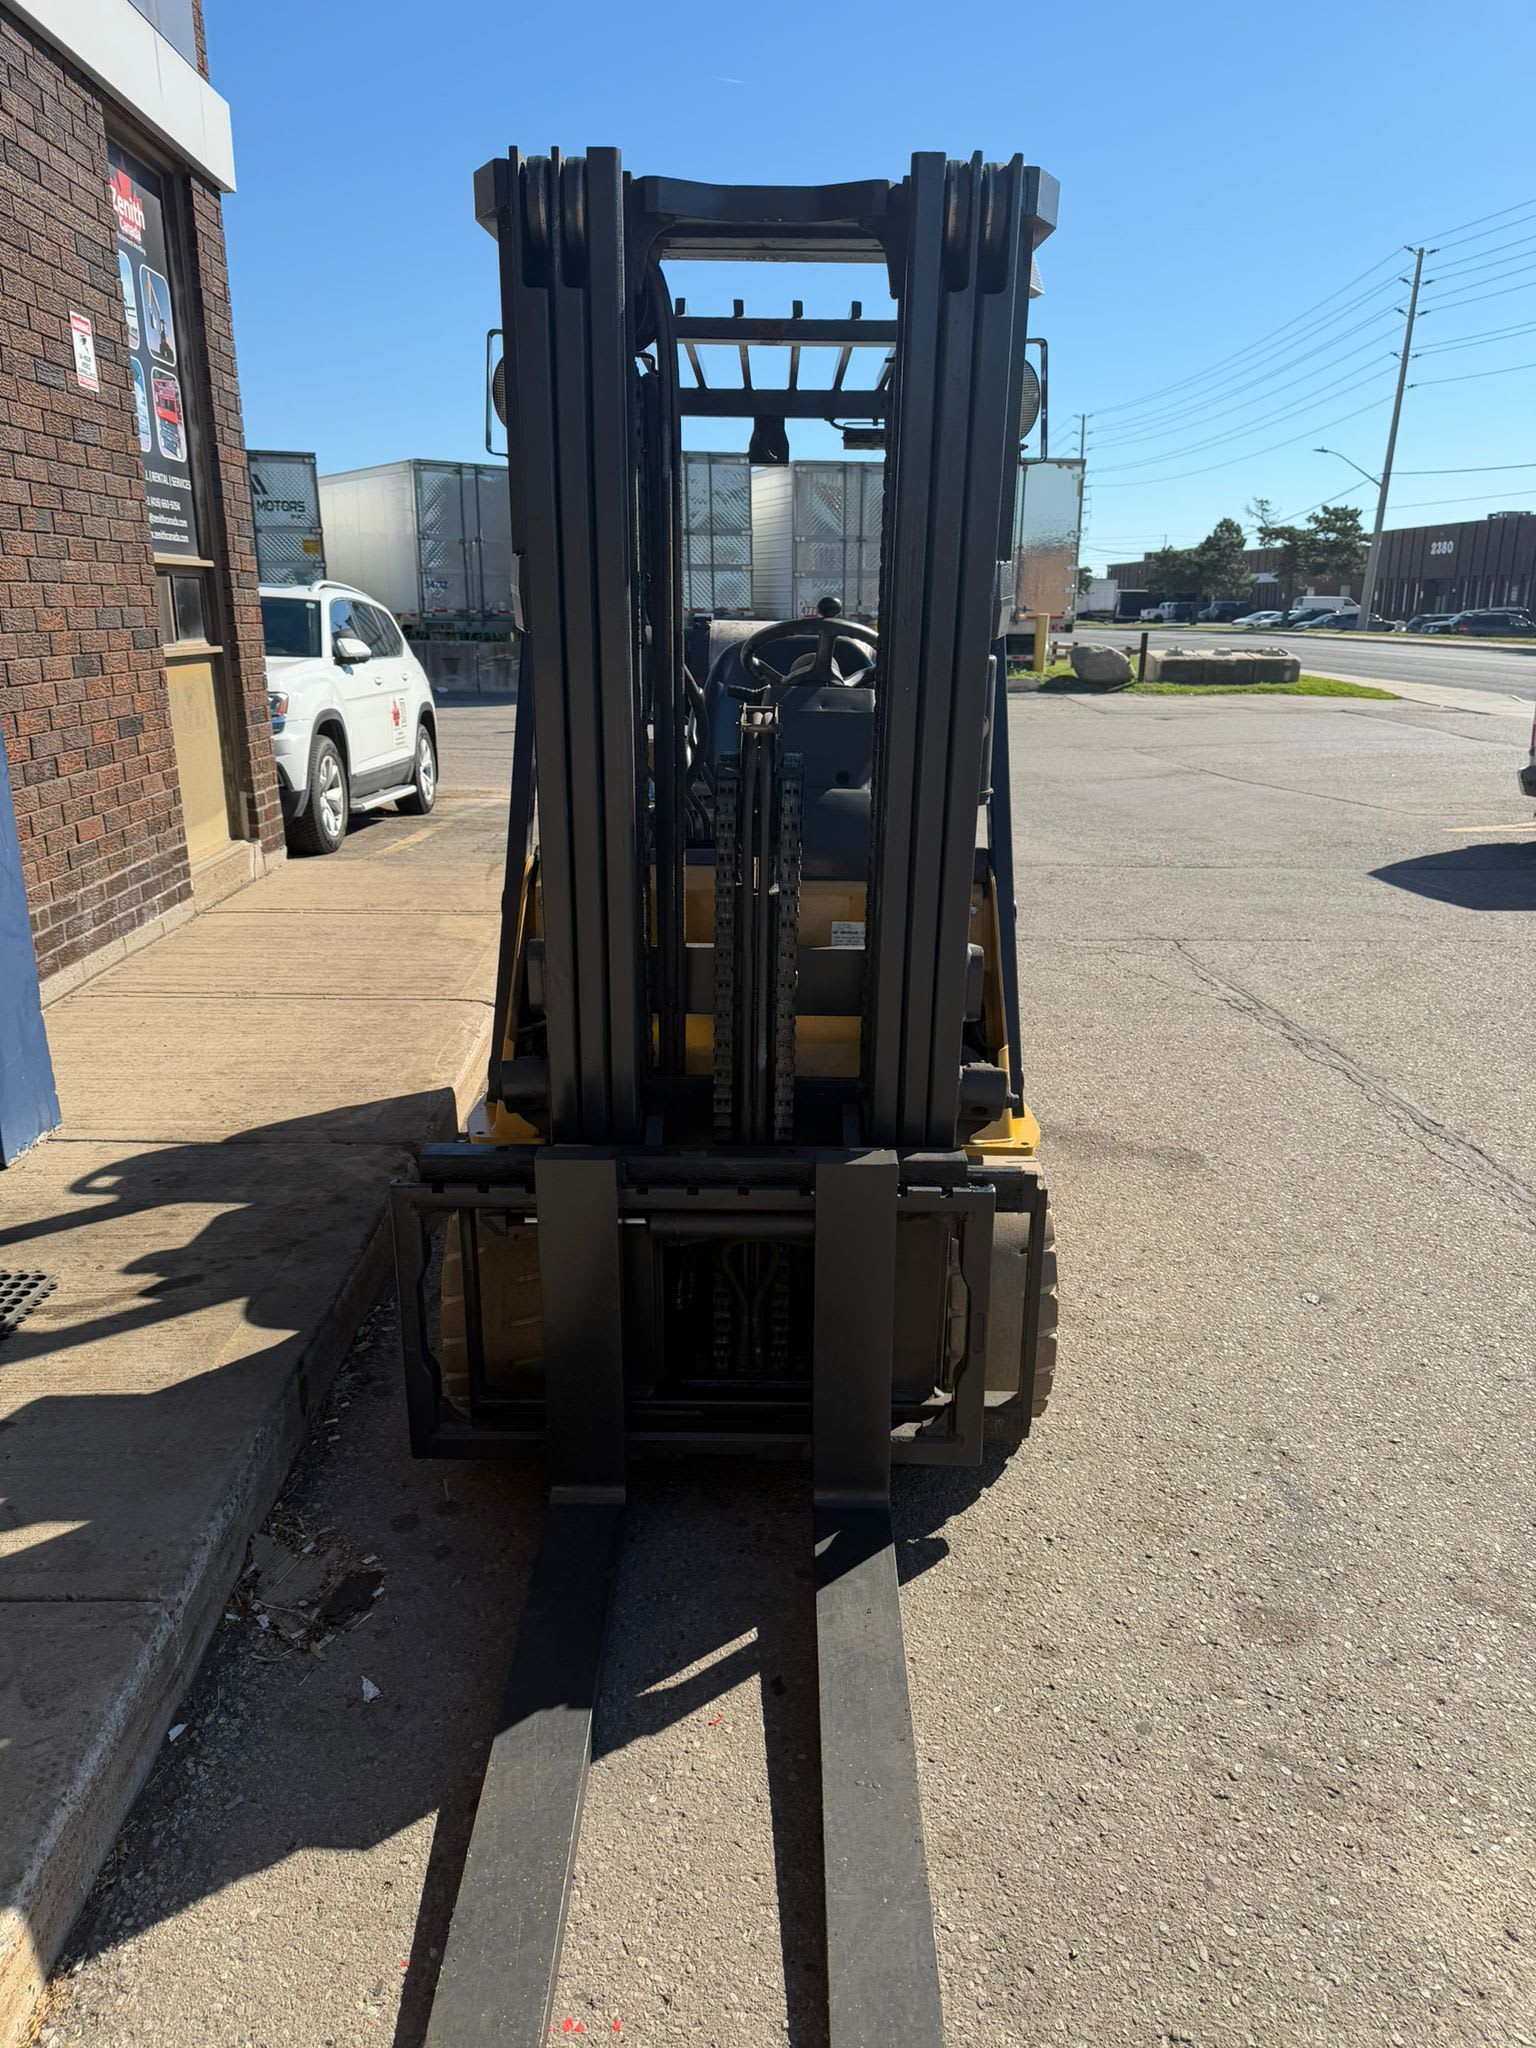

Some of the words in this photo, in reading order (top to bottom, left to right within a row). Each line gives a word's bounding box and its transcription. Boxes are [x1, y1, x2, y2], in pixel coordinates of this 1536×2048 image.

[110, 185, 146, 230] Zenith
[257, 500, 305, 512] MOTORS
[1430, 540, 1454, 555] 2380
